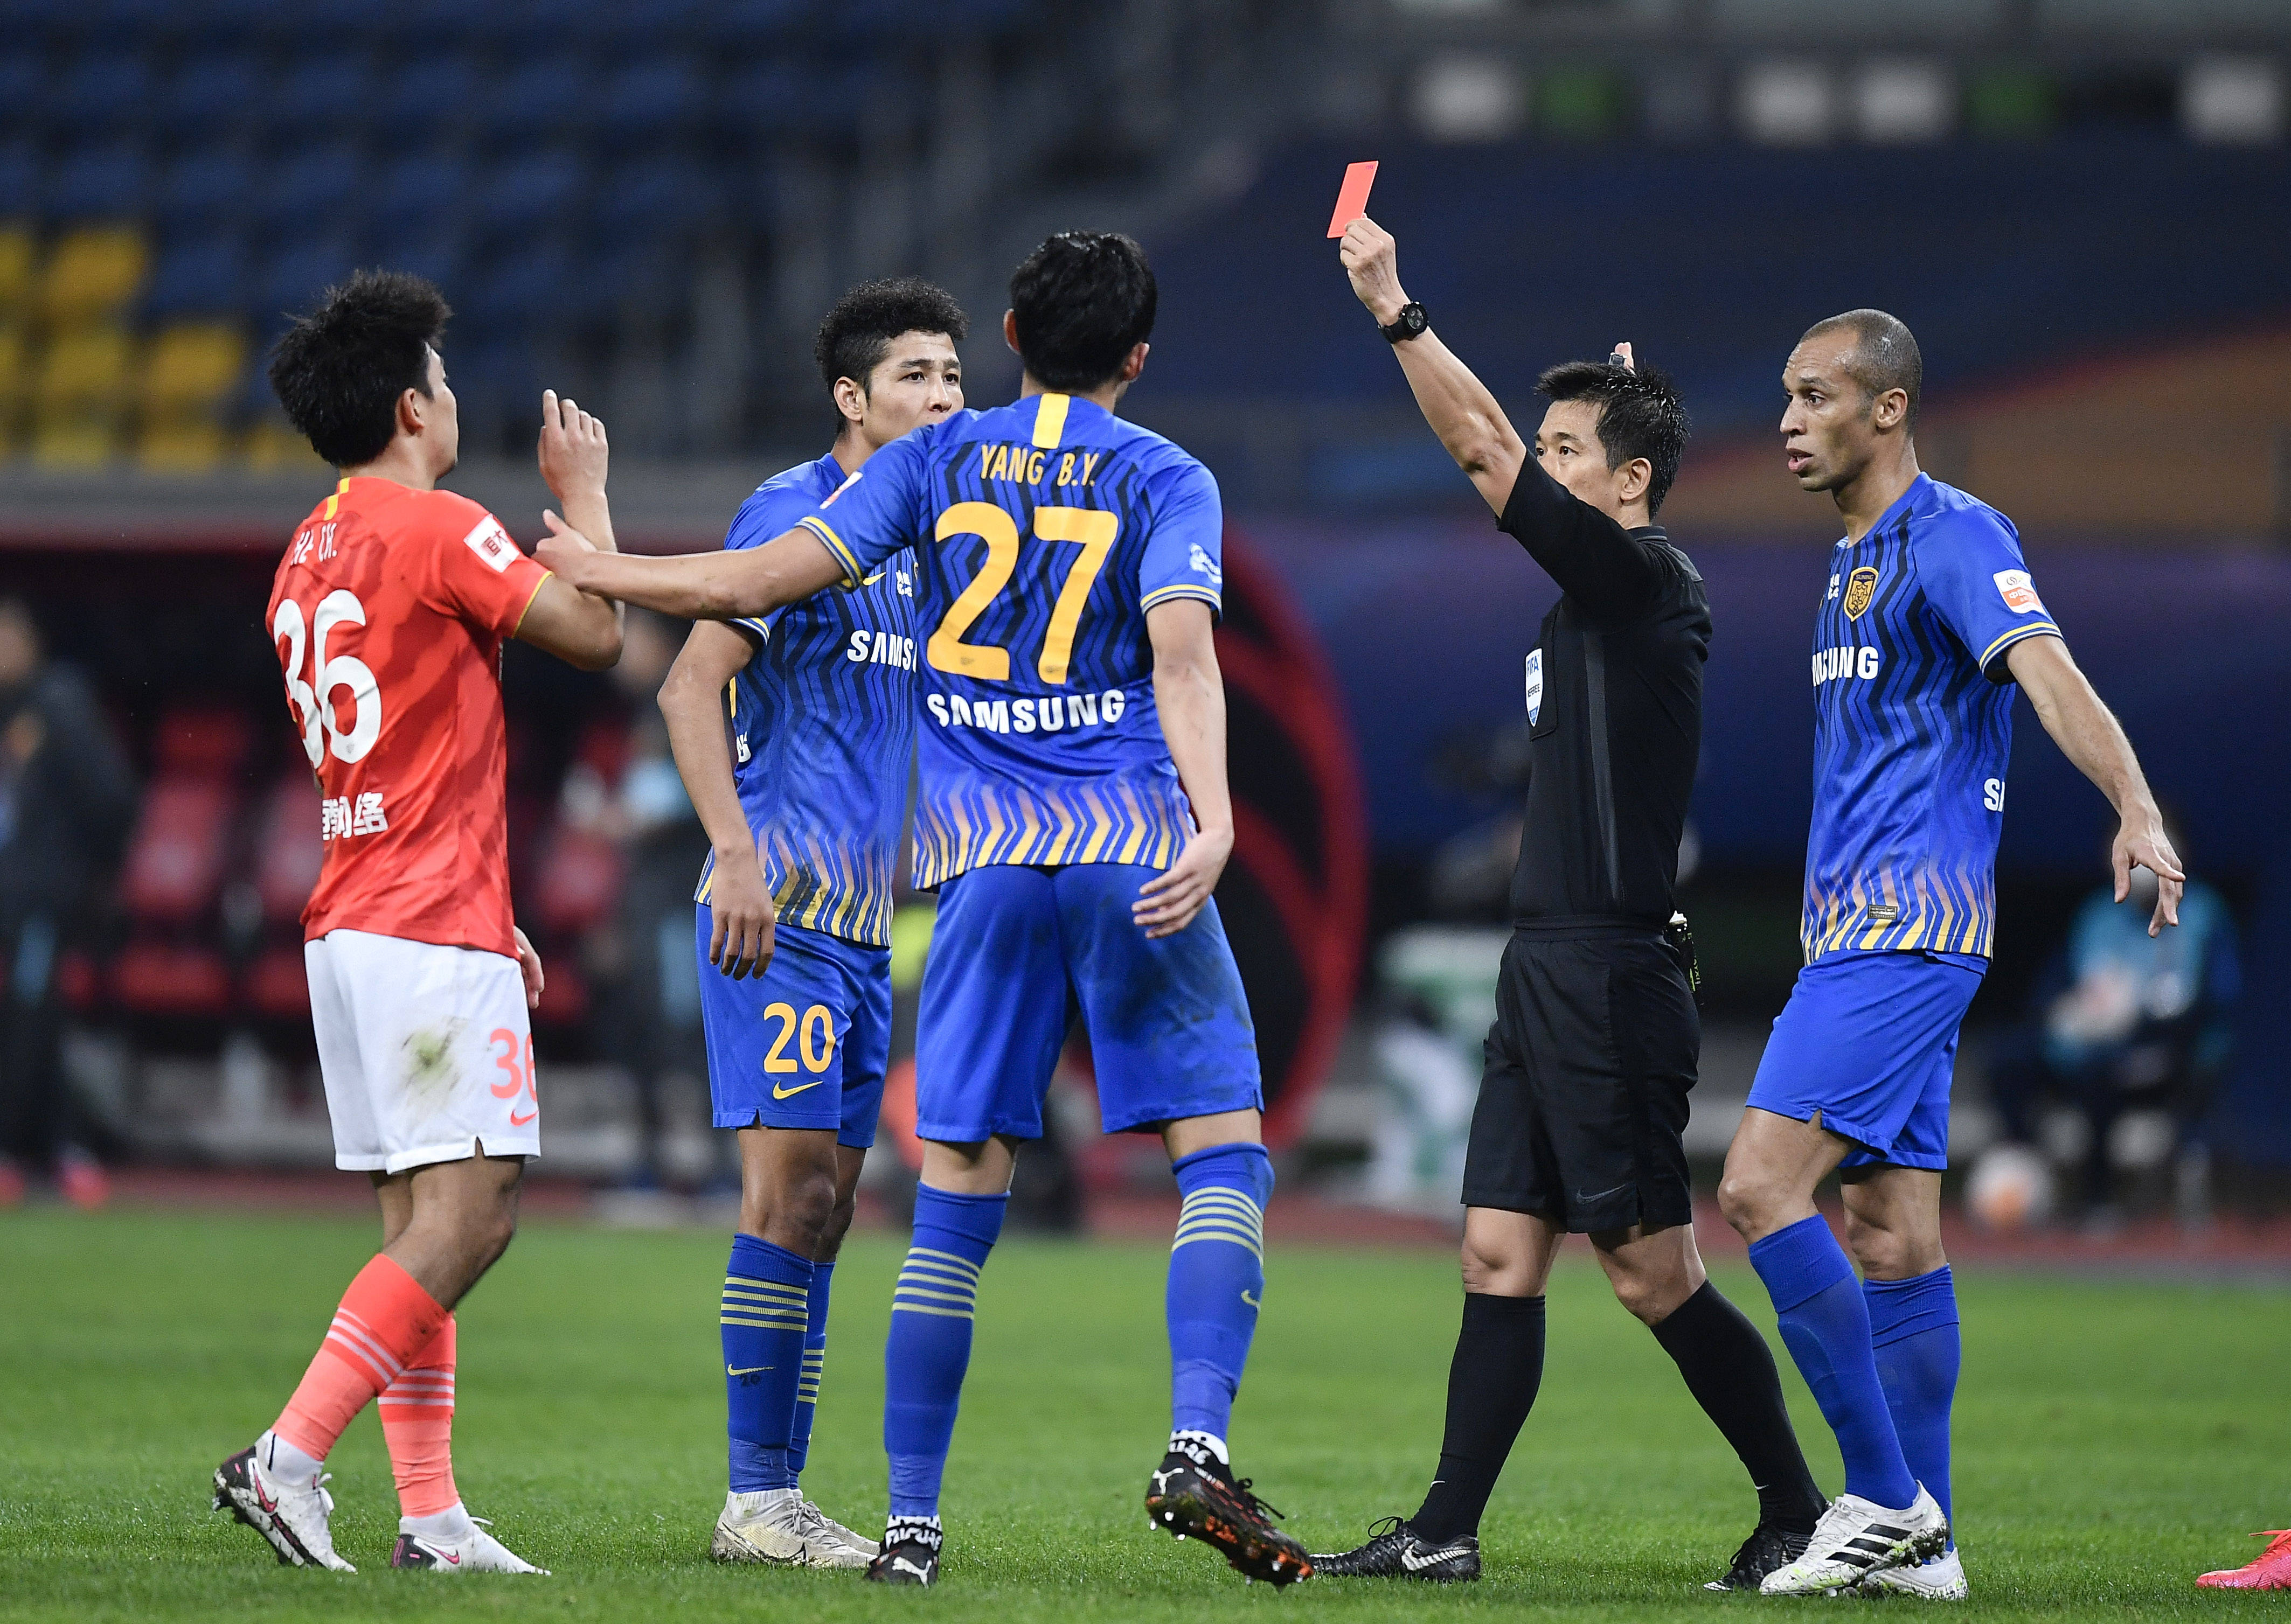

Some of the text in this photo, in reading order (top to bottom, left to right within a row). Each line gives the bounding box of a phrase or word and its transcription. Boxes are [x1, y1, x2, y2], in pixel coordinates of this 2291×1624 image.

[981, 444, 1099, 487] YANG B.Y.
[926, 500, 1119, 685] 27
[273, 589, 383, 770] 36
[1526, 654, 1539, 678] FIFA
[926, 689, 1126, 734] SAMSUNG
[763, 1002, 836, 1073] 20
